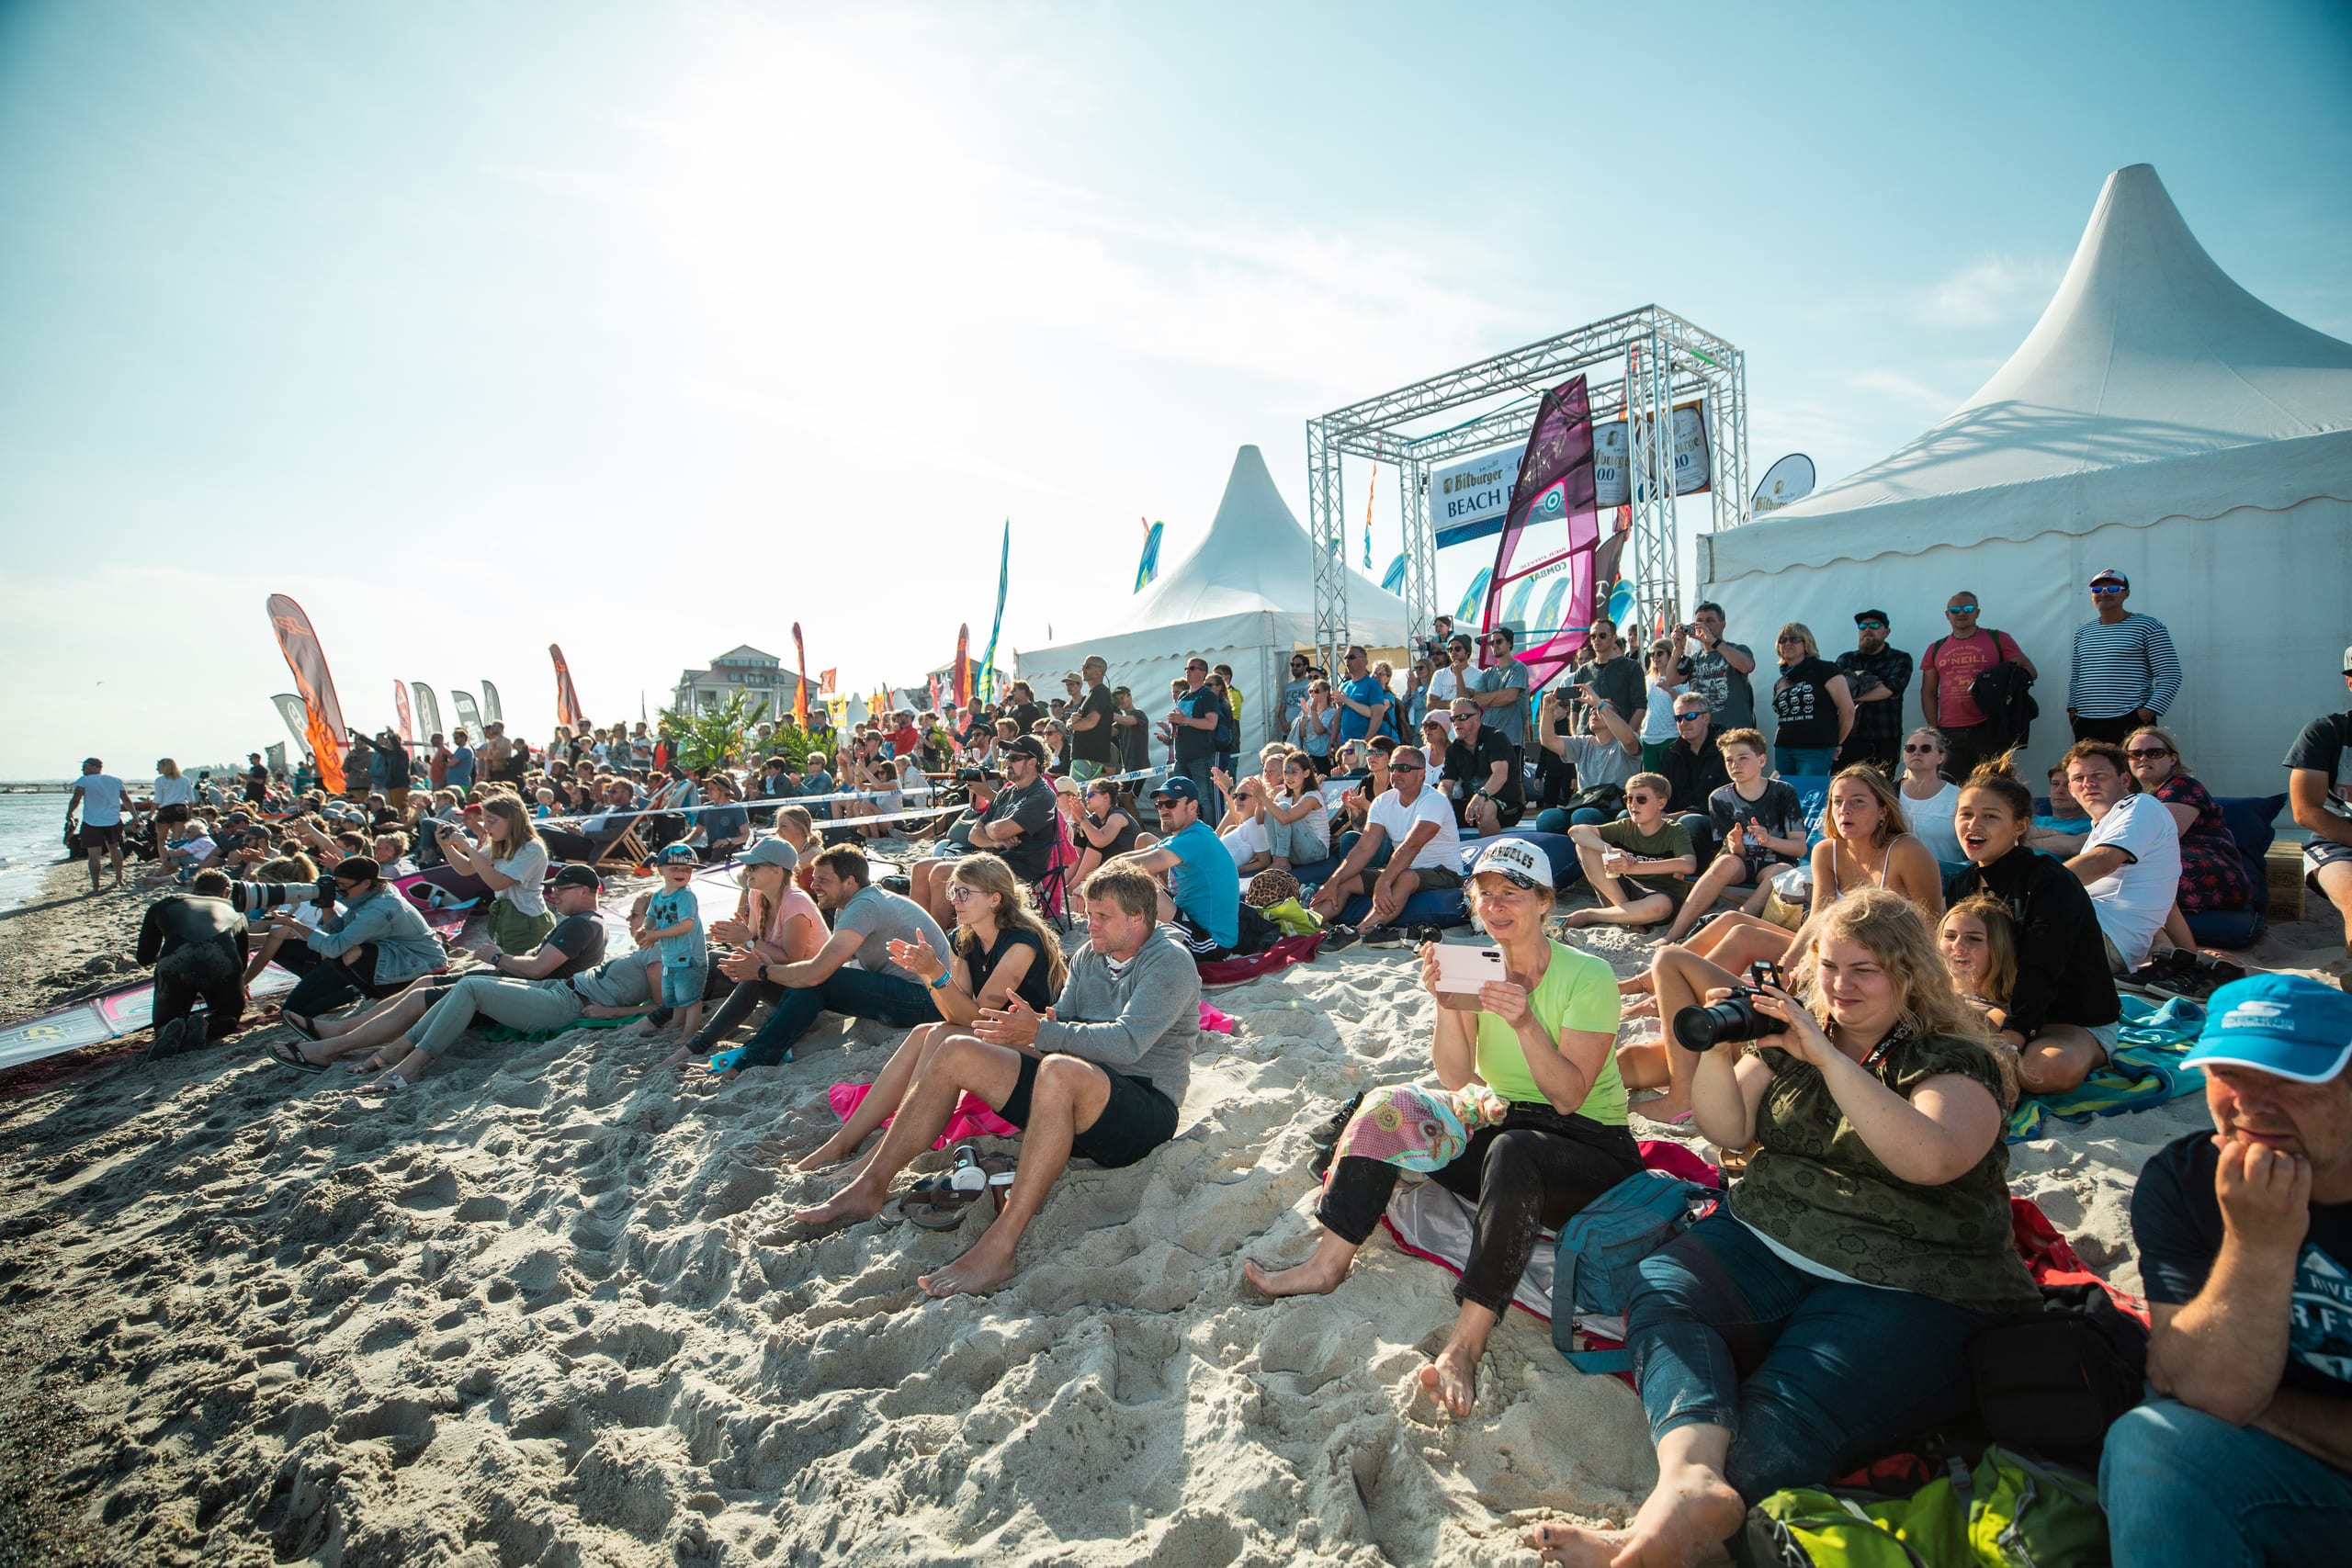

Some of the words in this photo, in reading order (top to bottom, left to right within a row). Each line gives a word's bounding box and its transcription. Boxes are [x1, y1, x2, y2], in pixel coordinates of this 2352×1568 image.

[1454, 469, 1502, 491] Bitburger
[1448, 489, 1501, 517] BEACH
[1939, 654, 1987, 667] O'NEILL
[1490, 846, 1534, 869] ANGELES
